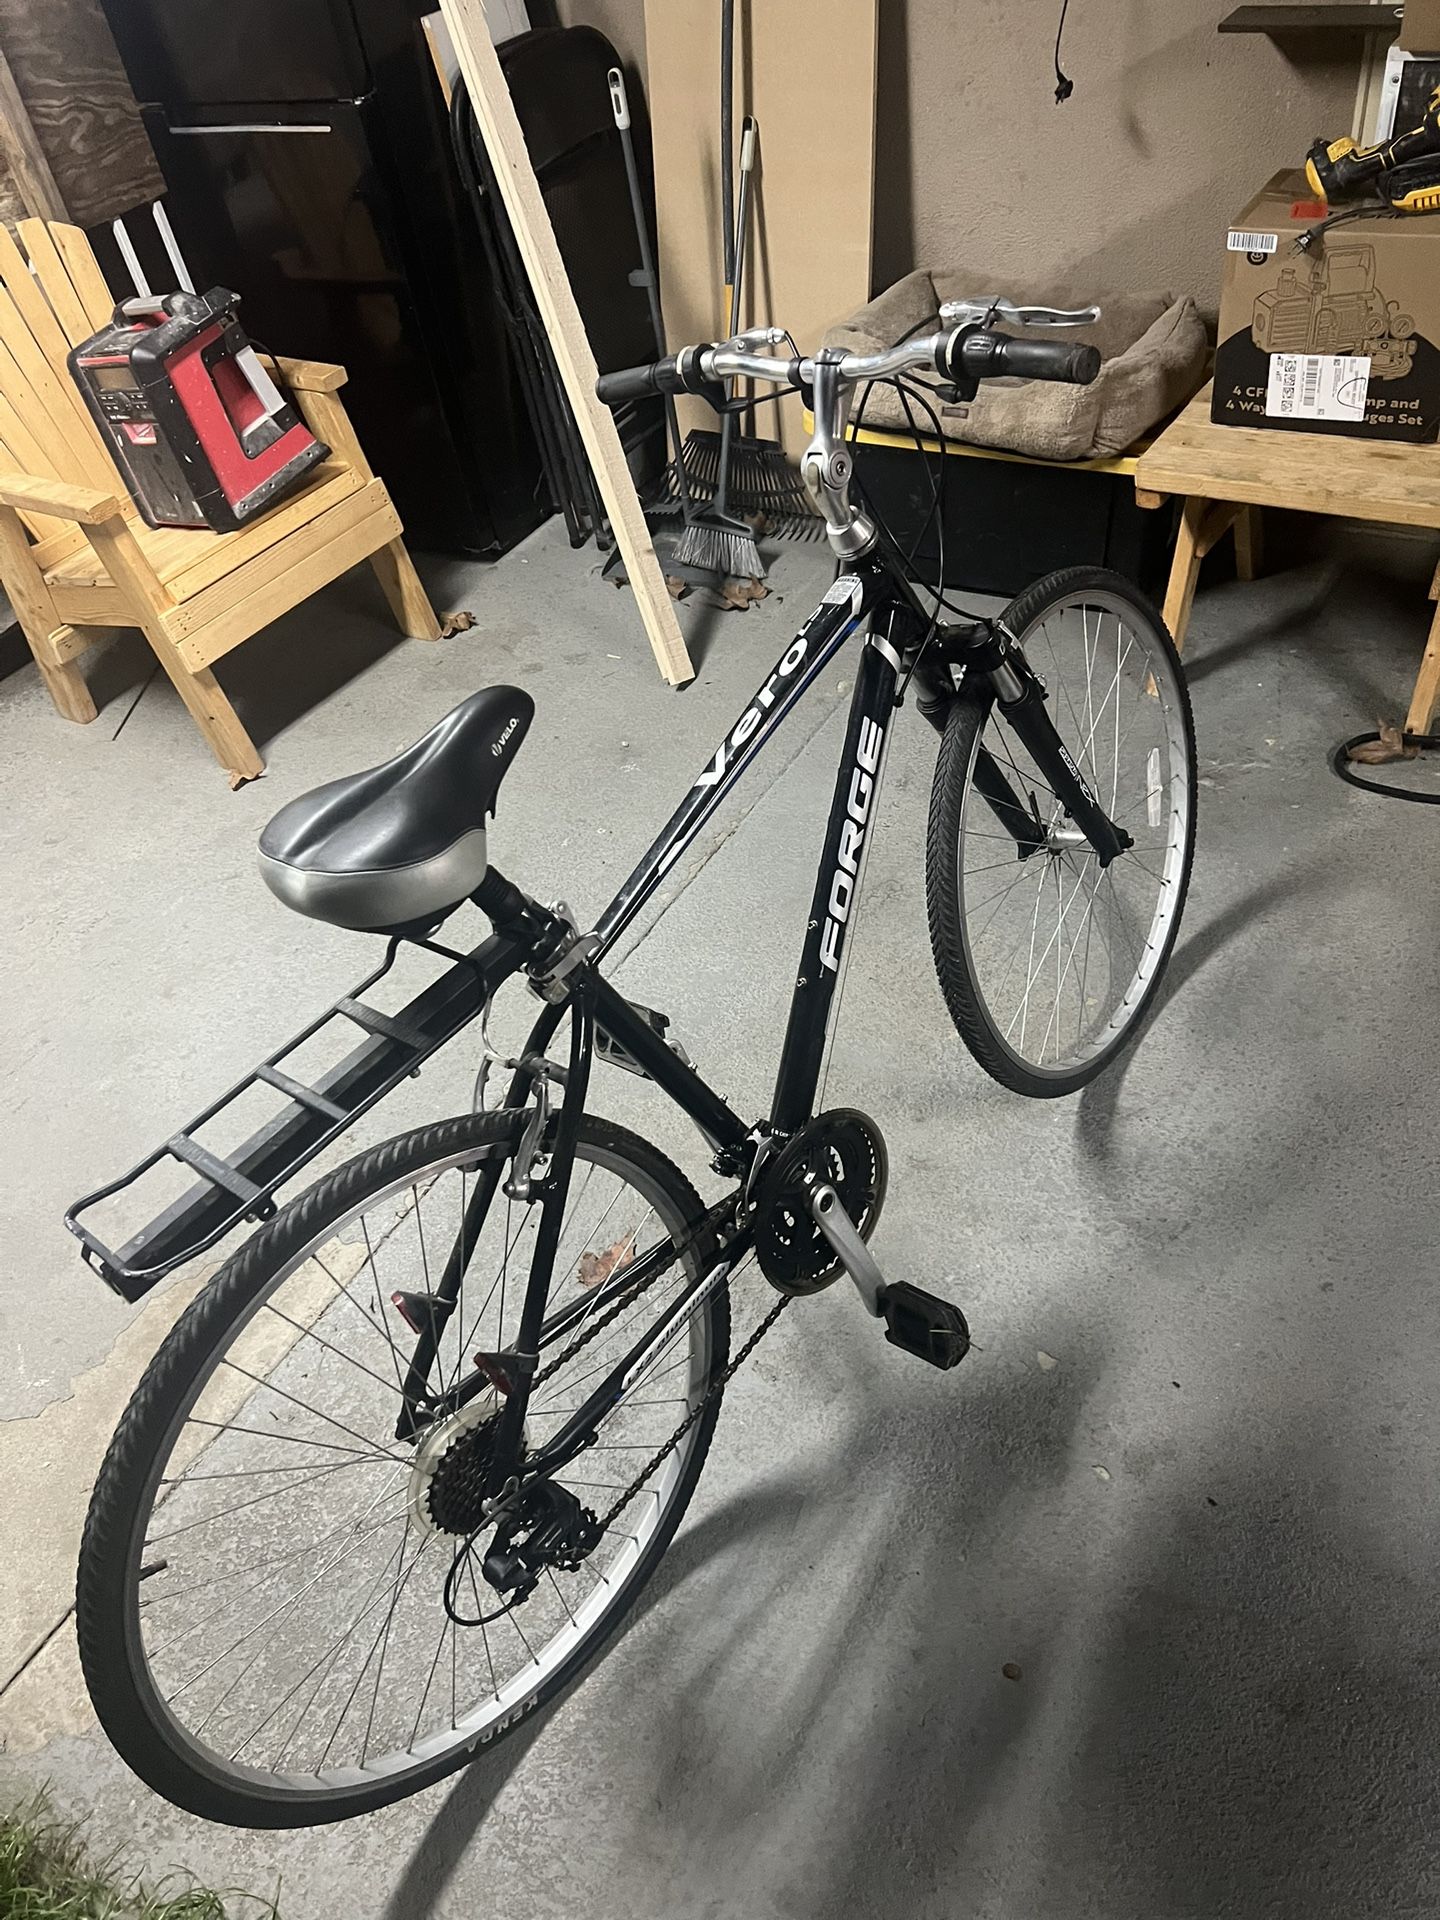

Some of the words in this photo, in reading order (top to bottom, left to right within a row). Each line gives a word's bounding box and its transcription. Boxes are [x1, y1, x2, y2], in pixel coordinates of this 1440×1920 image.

[1232, 385, 1242, 396] 4
[1390, 399, 1420, 410] and
[1226, 399, 1235, 410] 4
[1398, 413, 1424, 426] Set
[694, 637, 808, 786] Vero
[498, 718, 518, 745] VELO
[819, 715, 883, 973] FORGE
